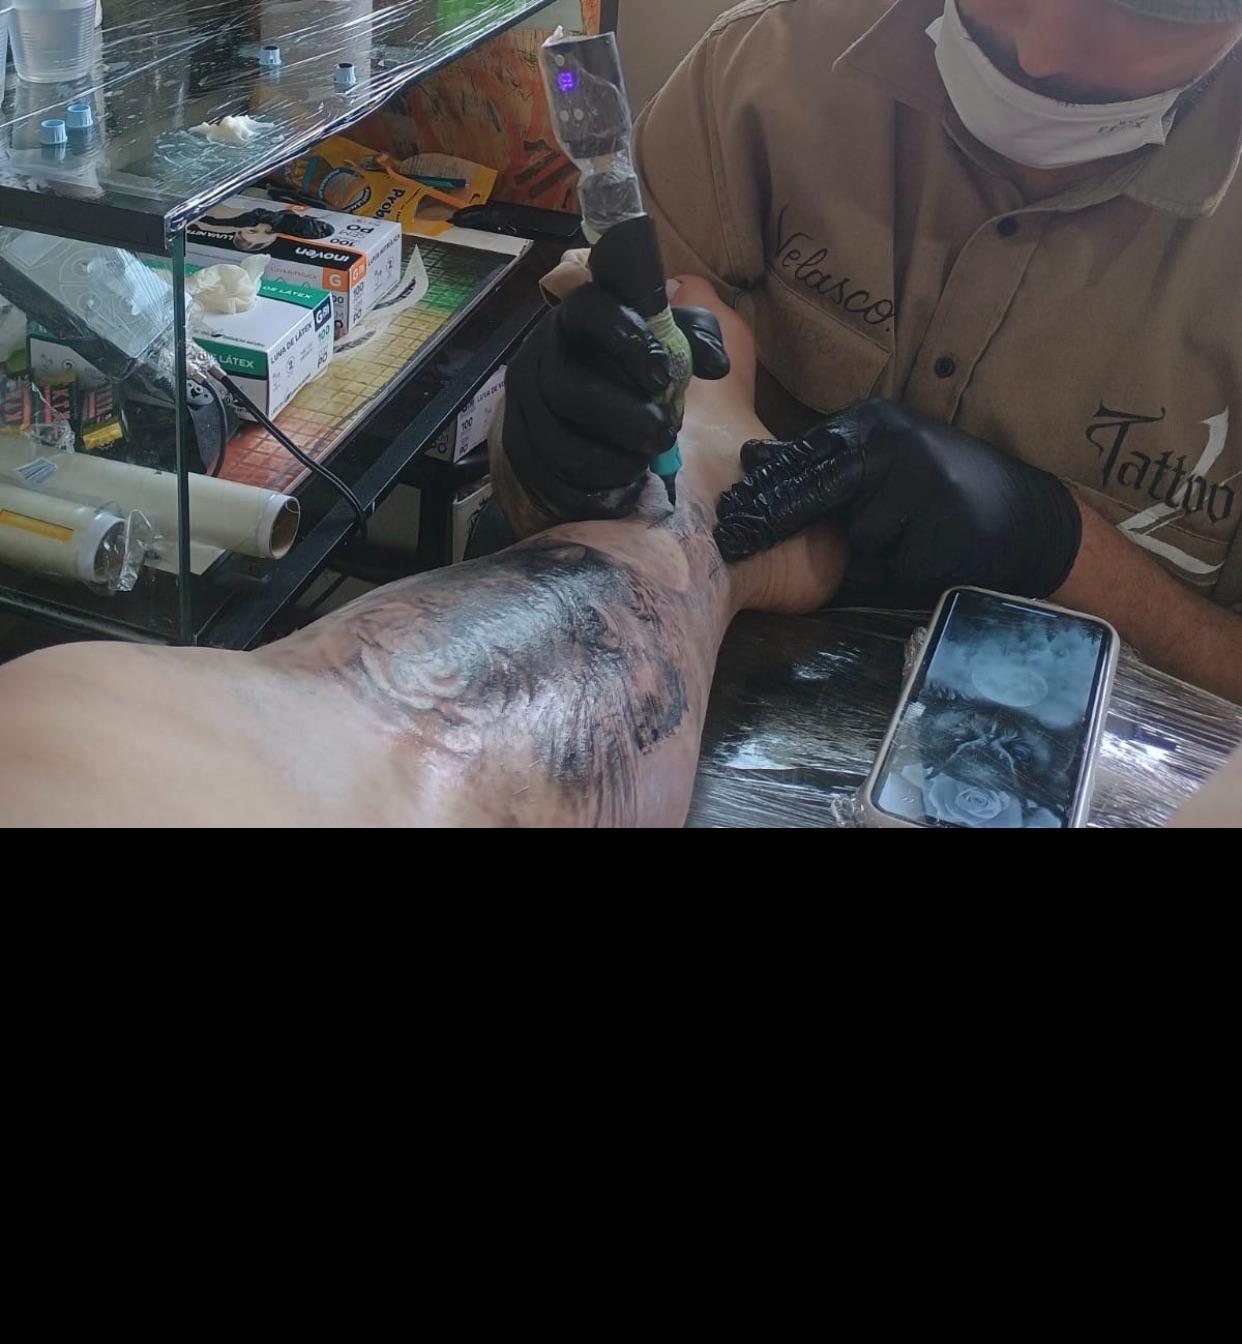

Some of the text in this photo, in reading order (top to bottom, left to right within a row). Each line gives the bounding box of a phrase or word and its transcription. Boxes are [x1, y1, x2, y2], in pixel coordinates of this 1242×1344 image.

[330, 238, 356, 247] 100
[295, 246, 350, 263] inoven
[329, 273, 342, 287] G
[318, 324, 330, 340] 100
[270, 348, 286, 365] LUVA
[286, 339, 295, 350] DE
[220, 353, 255, 369] LÁTEX
[477, 389, 491, 403] LUVA
[461, 416, 473, 430] 100
[1086, 399, 1235, 523] Tattoo
